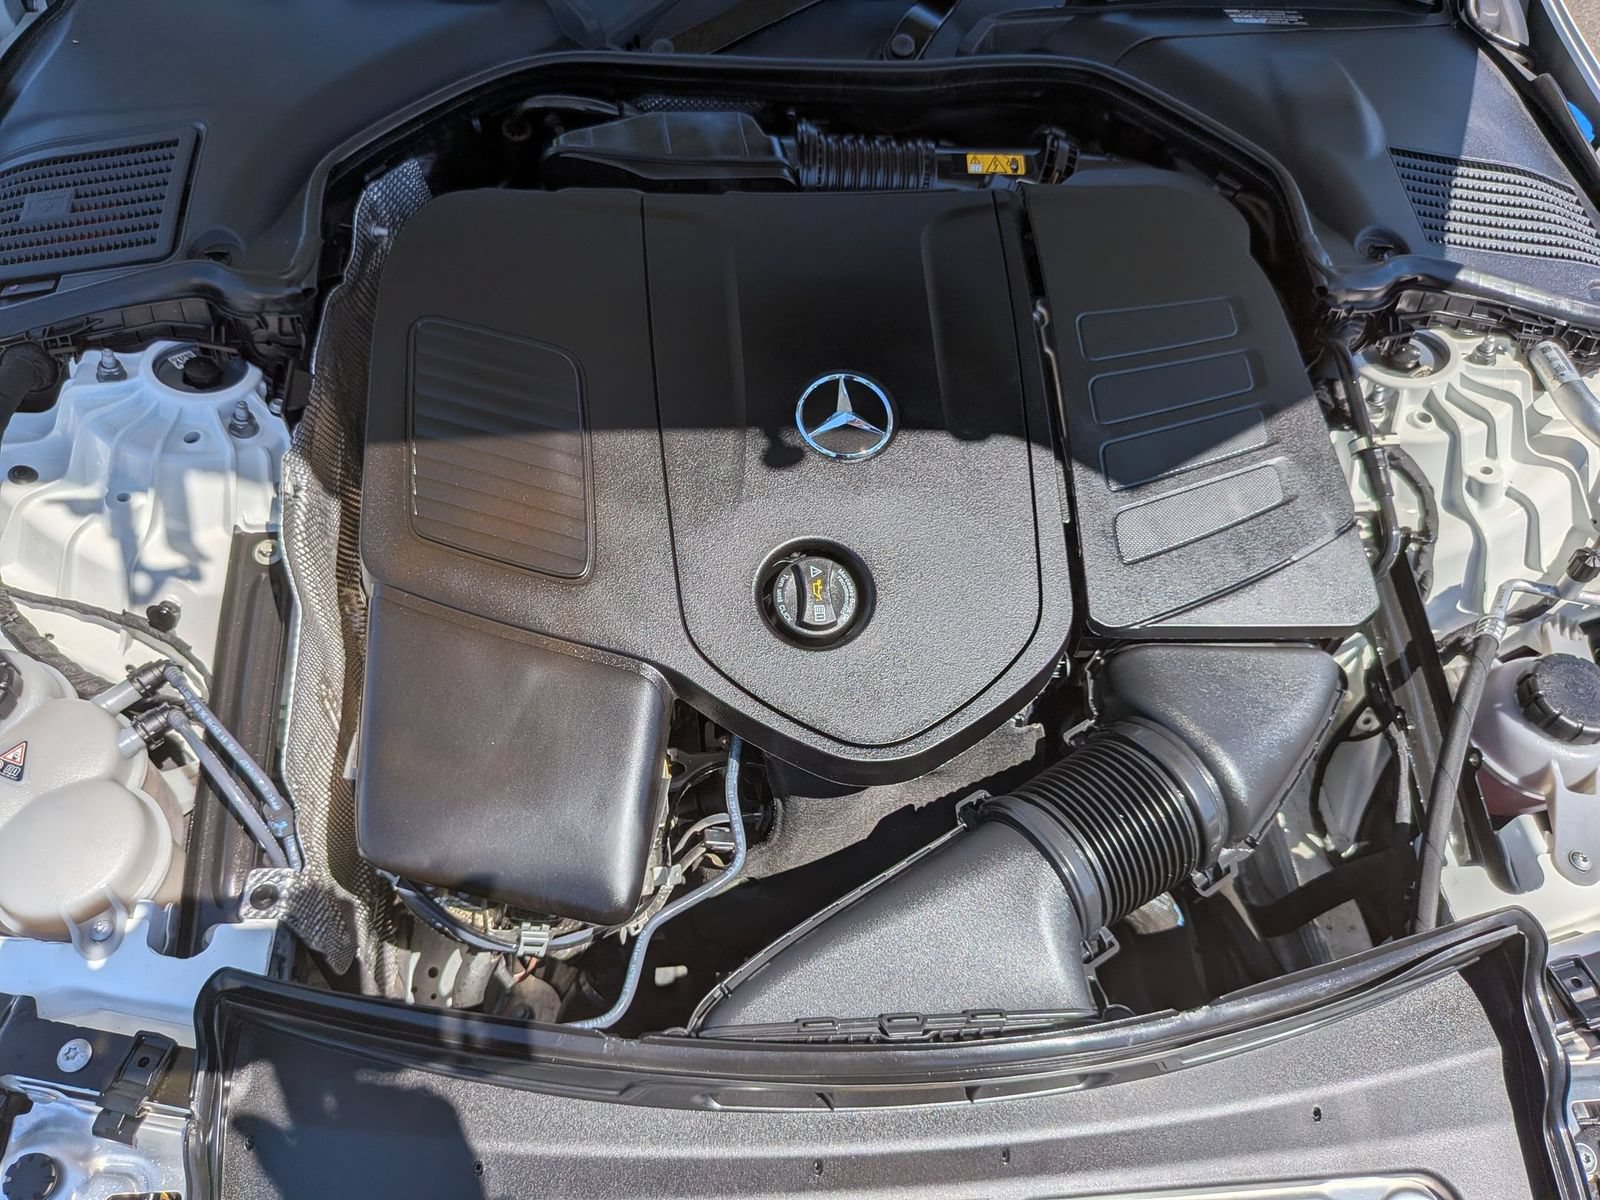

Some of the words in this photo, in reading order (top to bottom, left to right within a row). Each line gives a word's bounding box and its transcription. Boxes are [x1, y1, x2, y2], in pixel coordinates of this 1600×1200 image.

[777, 574, 790, 588] Turn
[776, 588, 784, 603] until
[778, 604, 793, 624] CLICK
